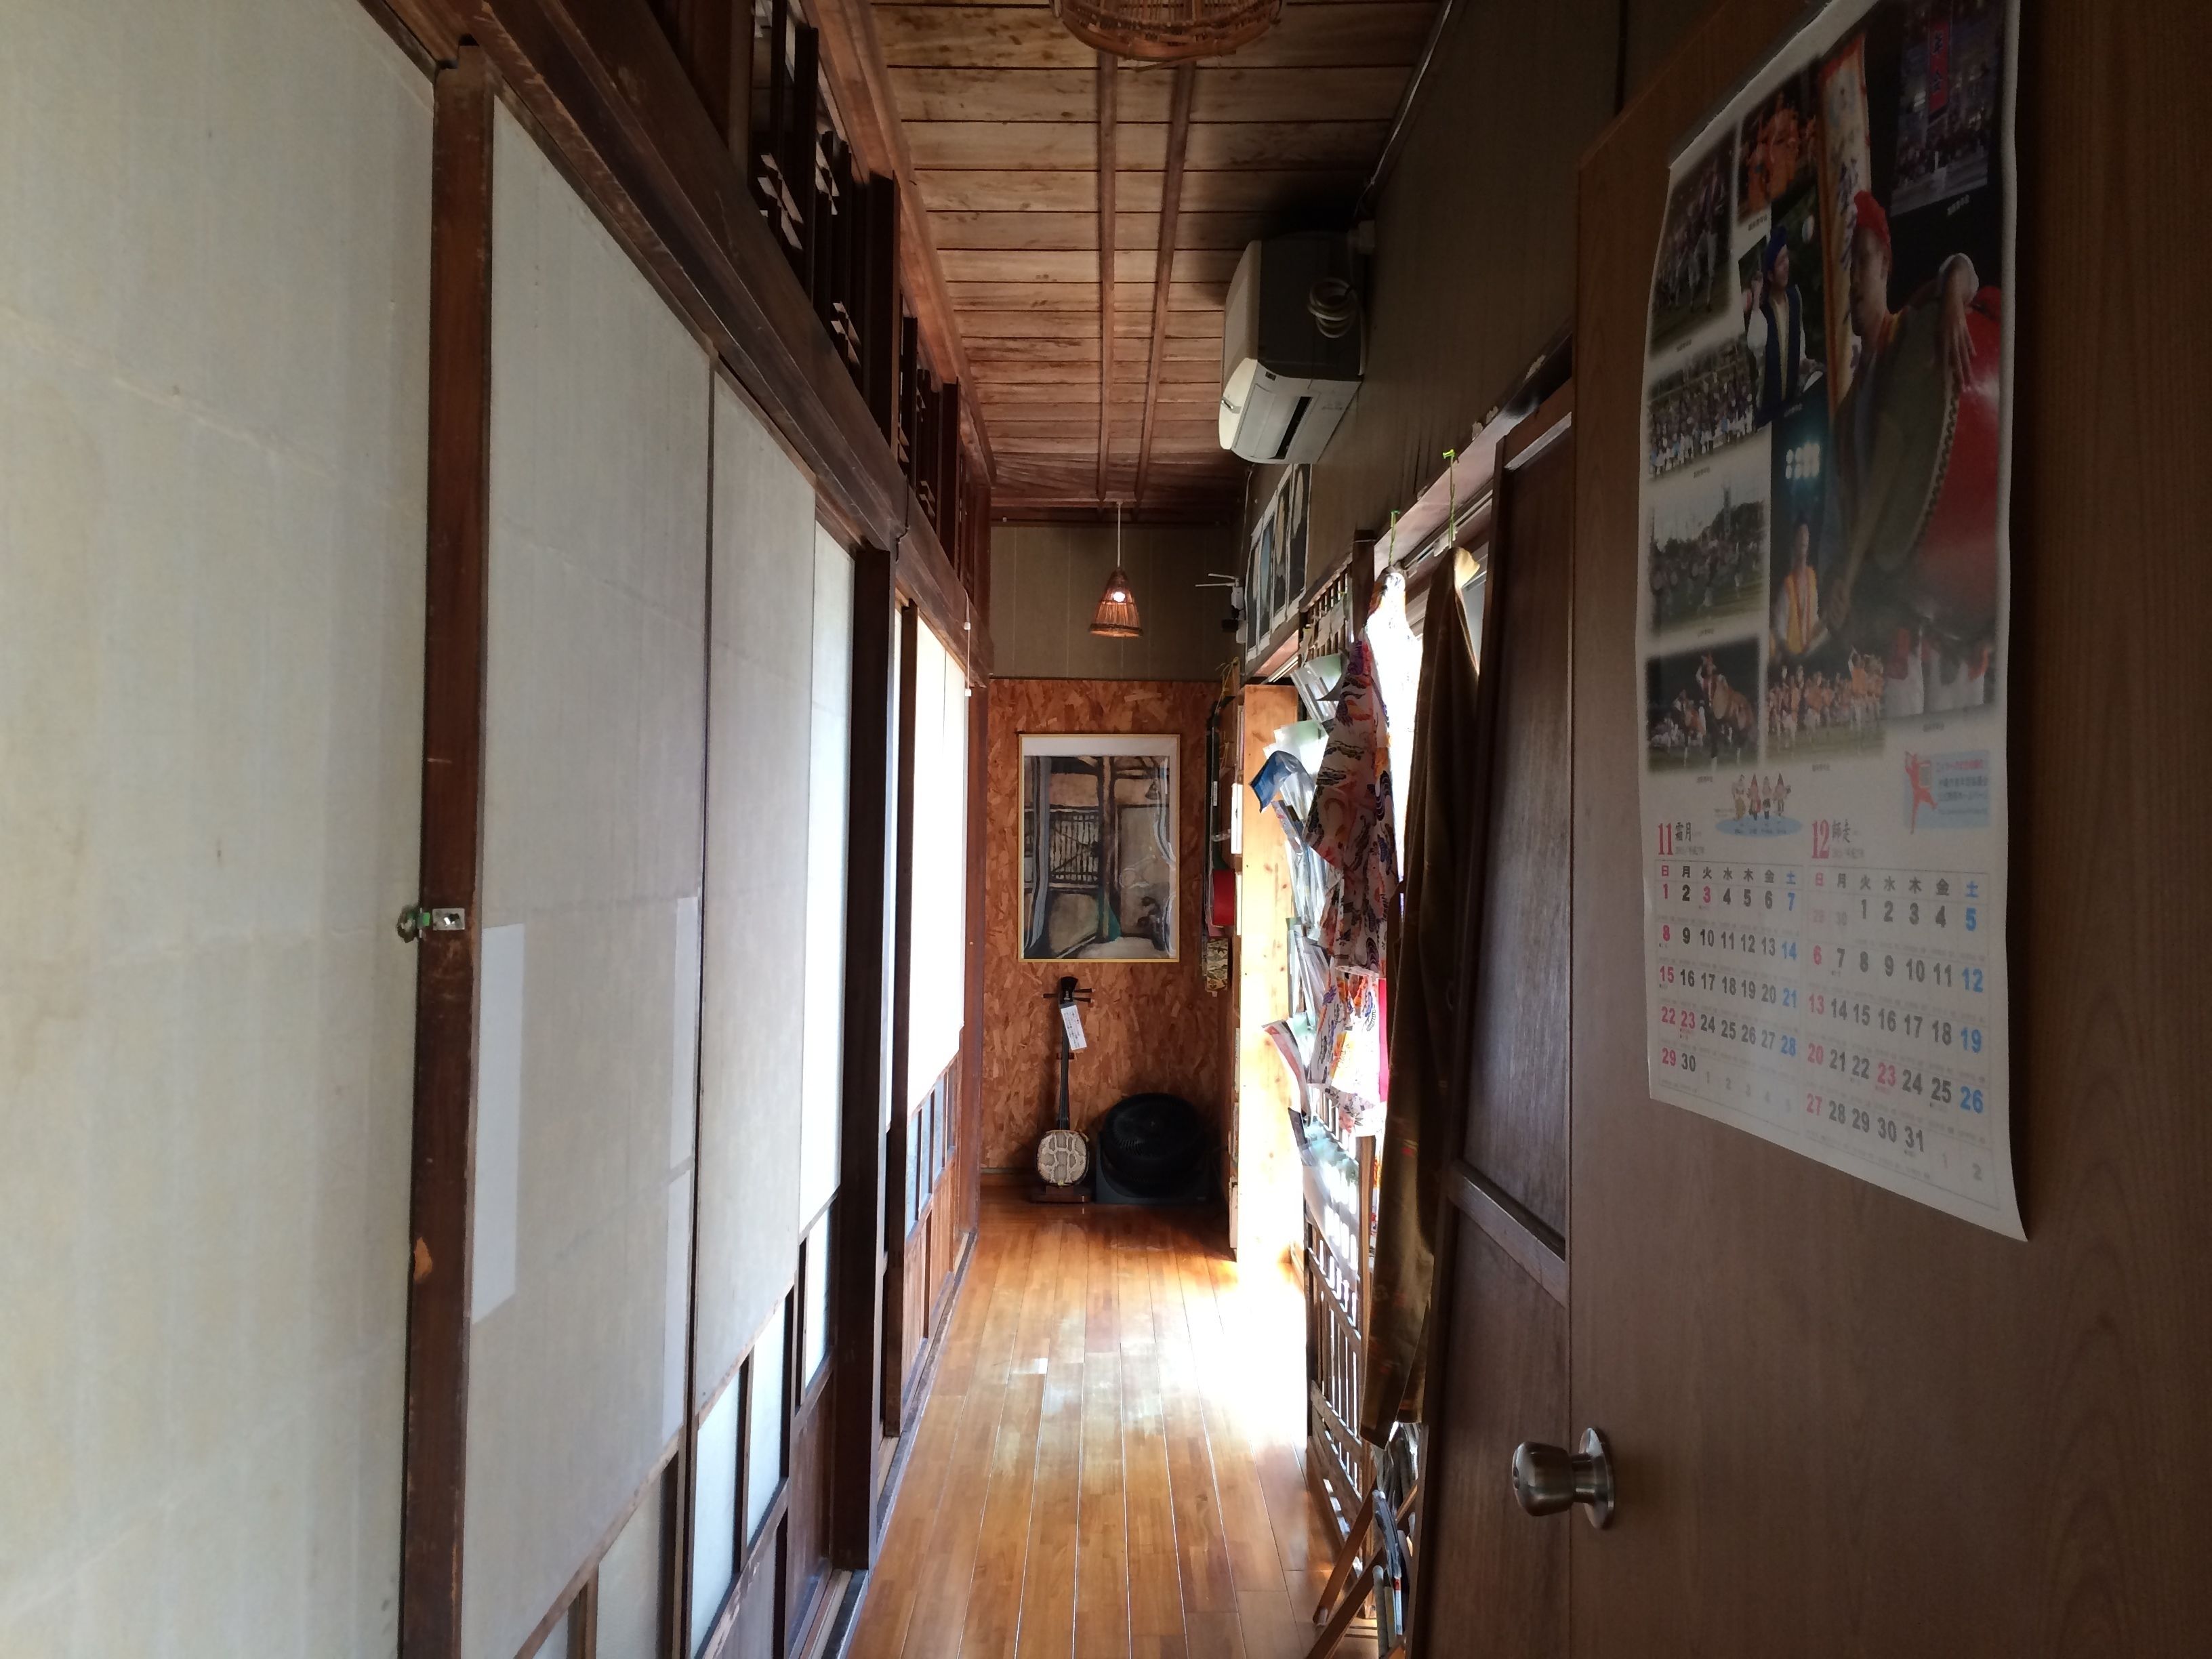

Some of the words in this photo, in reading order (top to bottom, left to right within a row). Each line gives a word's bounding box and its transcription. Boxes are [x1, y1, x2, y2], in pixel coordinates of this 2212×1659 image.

[1658, 823, 1673, 855] 11
[1675, 822, 1691, 842] 霜月
[1812, 819, 1830, 859] 12
[1662, 865, 1668, 876] 日
[1682, 866, 1690, 878] 月
[1702, 867, 1712, 879] 火
[1723, 867, 1732, 880] 水
[1744, 868, 1753, 882] 木
[1765, 869, 1774, 883] 金
[1786, 871, 1796, 884] 土
[1816, 872, 1824, 886] 日
[1837, 873, 1846, 888] 月
[1860, 875, 1870, 890] 火
[1884, 876, 1895, 891] 水
[1909, 877, 1921, 893] 木
[1936, 878, 1949, 896] 金
[1965, 881, 1978, 898] 土
[1663, 884, 1668, 899] 1
[1682, 884, 1689, 901] 2
[1703, 886, 1711, 903] 3
[1723, 888, 1731, 905] 4
[1744, 889, 1751, 907] 5
[1765, 890, 1772, 909] 6
[1788, 893, 1795, 911] 7
[1862, 899, 1866, 919] 1
[1884, 901, 1893, 922] 2
[1909, 903, 1919, 924] 3
[1936, 905, 1946, 928] 4
[1966, 907, 1976, 931] 5
[1663, 925, 1670, 941] 8
[1683, 927, 1690, 944] 9
[1700, 929, 1714, 947] 10
[1721, 931, 1734, 949] 11
[1741, 934, 1755, 953] 12
[1761, 937, 1775, 956] 13
[1782, 941, 1797, 960] 14
[1660, 966, 1674, 983] 15
[1681, 969, 1694, 987] 16
[1701, 972, 1715, 990] 17
[1722, 976, 1736, 995] 18
[1742, 980, 1756, 999] 19
[1761, 983, 1776, 1004] 20
[1783, 987, 1797, 1008] 21
[1814, 945, 1822, 965] 6
[1837, 948, 1845, 968] 7
[1860, 951, 1868, 972] 8
[1885, 955, 1893, 977] 9
[1906, 958, 1925, 983] 10
[1933, 963, 1951, 987] 11
[1962, 968, 1983, 993] 12
[1662, 1006, 1675, 1025] 22
[1681, 1010, 1695, 1029] 23
[1701, 1015, 1715, 1033] 24
[1721, 1020, 1736, 1040] 25
[1741, 1024, 1756, 1044] 26
[1761, 1029, 1776, 1049] 27
[1781, 1036, 1796, 1057] 28
[1809, 994, 1824, 1015] 13
[1831, 998, 1847, 1020] 14
[1853, 1004, 1870, 1025] 15
[1879, 1008, 1896, 1032] 16
[1904, 1014, 1923, 1038] 17
[1932, 1021, 1951, 1046] 18
[1961, 1027, 1982, 1053] 19
[1662, 1048, 1676, 1066] 29
[1681, 1053, 1696, 1071] 30
[1725, 1078, 1732, 1090] 2
[1807, 1043, 1824, 1065] 20
[1830, 1049, 1845, 1071] 21
[1852, 1055, 1870, 1079] 22
[1877, 1062, 1896, 1086] 23
[1902, 1069, 1923, 1095] 24
[1931, 1078, 1951, 1103] 25
[1960, 1086, 1983, 1113] 26
[1807, 1093, 1822, 1115] 27
[1829, 1101, 1845, 1124] 28
[1852, 1108, 1870, 1132] 29
[1877, 1117, 1897, 1143] 30
[1904, 1126, 1923, 1153] 31
[1972, 1163, 1982, 1181] 2
